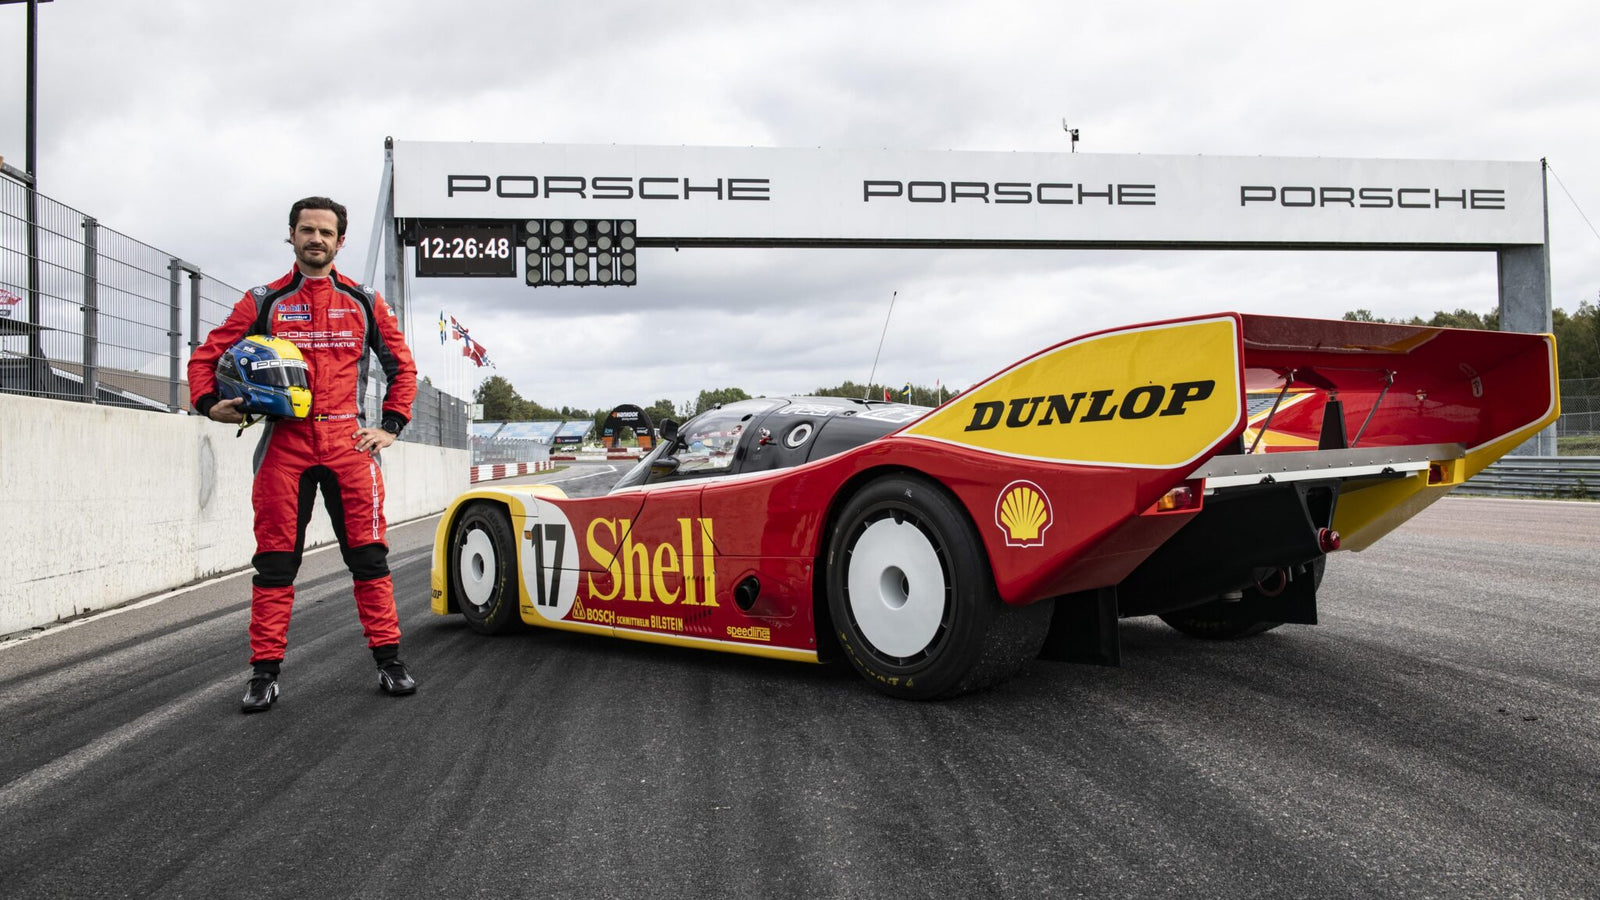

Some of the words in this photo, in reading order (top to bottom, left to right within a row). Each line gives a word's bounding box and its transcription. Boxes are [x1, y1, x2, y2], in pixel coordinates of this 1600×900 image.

[447, 174, 771, 201] PORSCHE
[863, 180, 1156, 206] PORSCHE
[1240, 185, 1506, 210] PORSCHE
[420, 237, 510, 259] 12:26:48
[278, 304, 300, 312] Mobil
[964, 380, 1216, 432] DUNLOP
[370, 463, 380, 540] PORSCHE
[531, 523, 567, 608] 17
[585, 517, 721, 607] Shell
[586, 608, 615, 625] BOSCH
[650, 615, 684, 631] BILSTEIN
[726, 626, 771, 641] speedline
